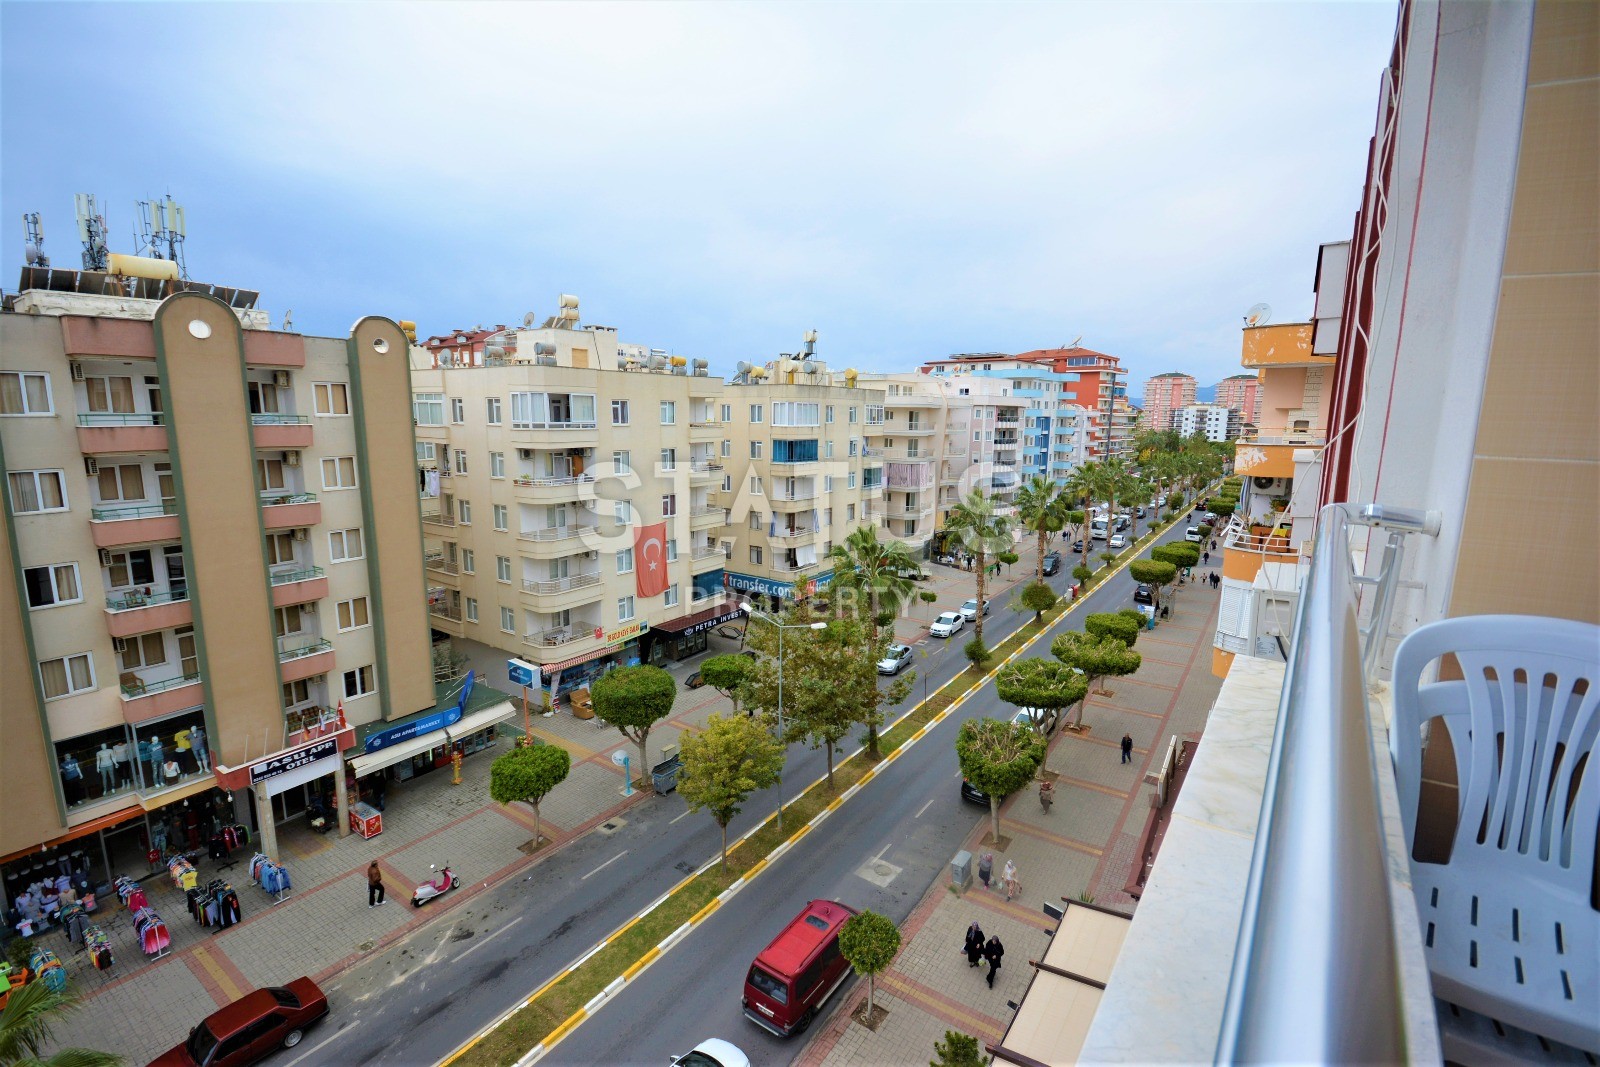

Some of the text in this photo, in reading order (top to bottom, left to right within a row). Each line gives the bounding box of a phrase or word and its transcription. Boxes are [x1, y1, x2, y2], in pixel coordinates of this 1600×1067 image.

[695, 610, 742, 632] PETRA INVEST
[286, 755, 316, 770] OTEL
